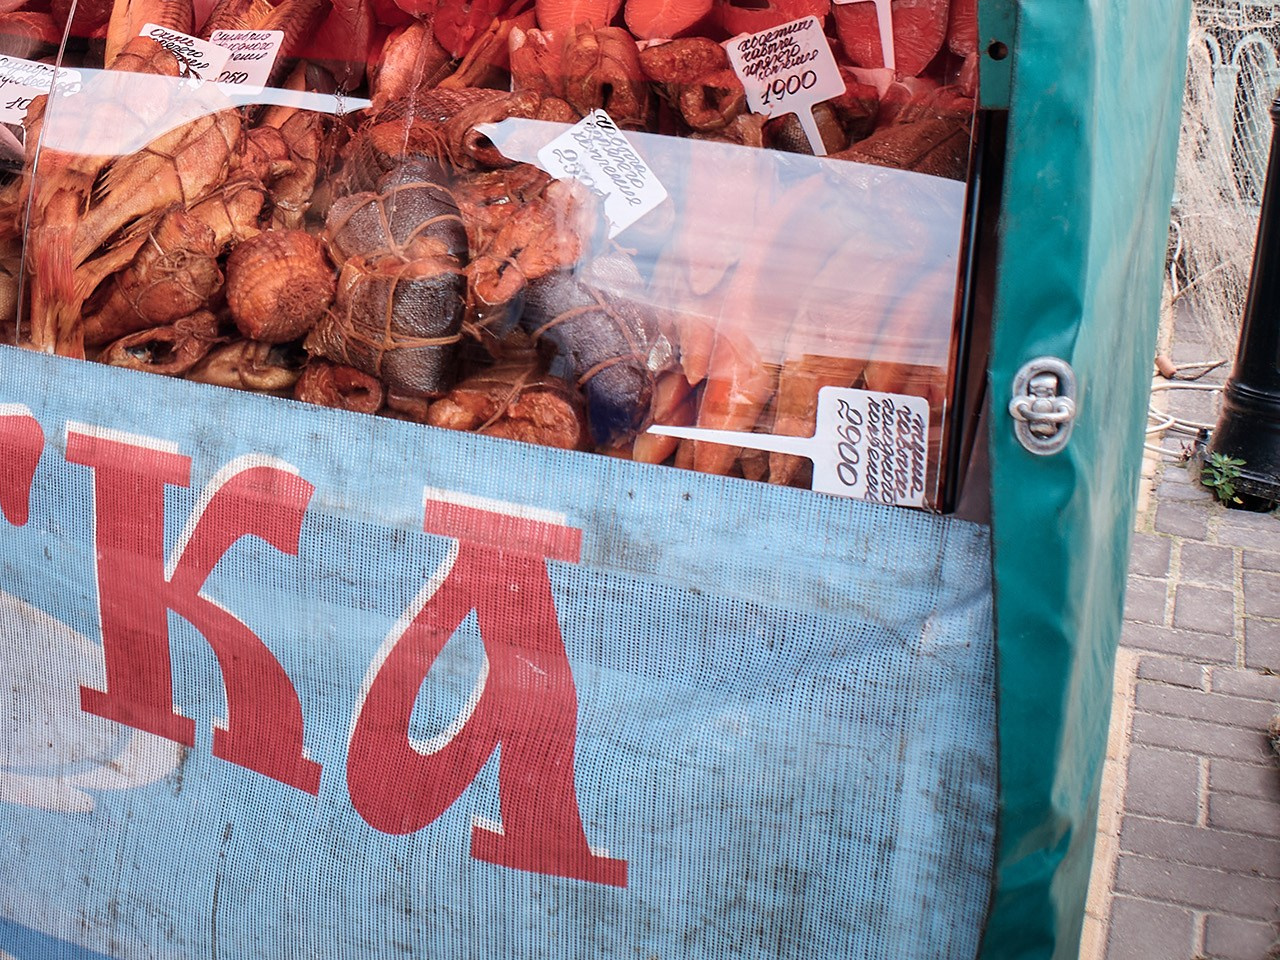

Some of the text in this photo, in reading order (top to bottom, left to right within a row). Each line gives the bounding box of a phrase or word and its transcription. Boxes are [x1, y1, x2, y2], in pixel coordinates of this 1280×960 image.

[216, 41, 275, 51] лодного
[220, 70, 249, 85] 050
[760, 70, 818, 106] 1900
[5, 96, 33, 111] 10
[836, 398, 863, 487] 2900
